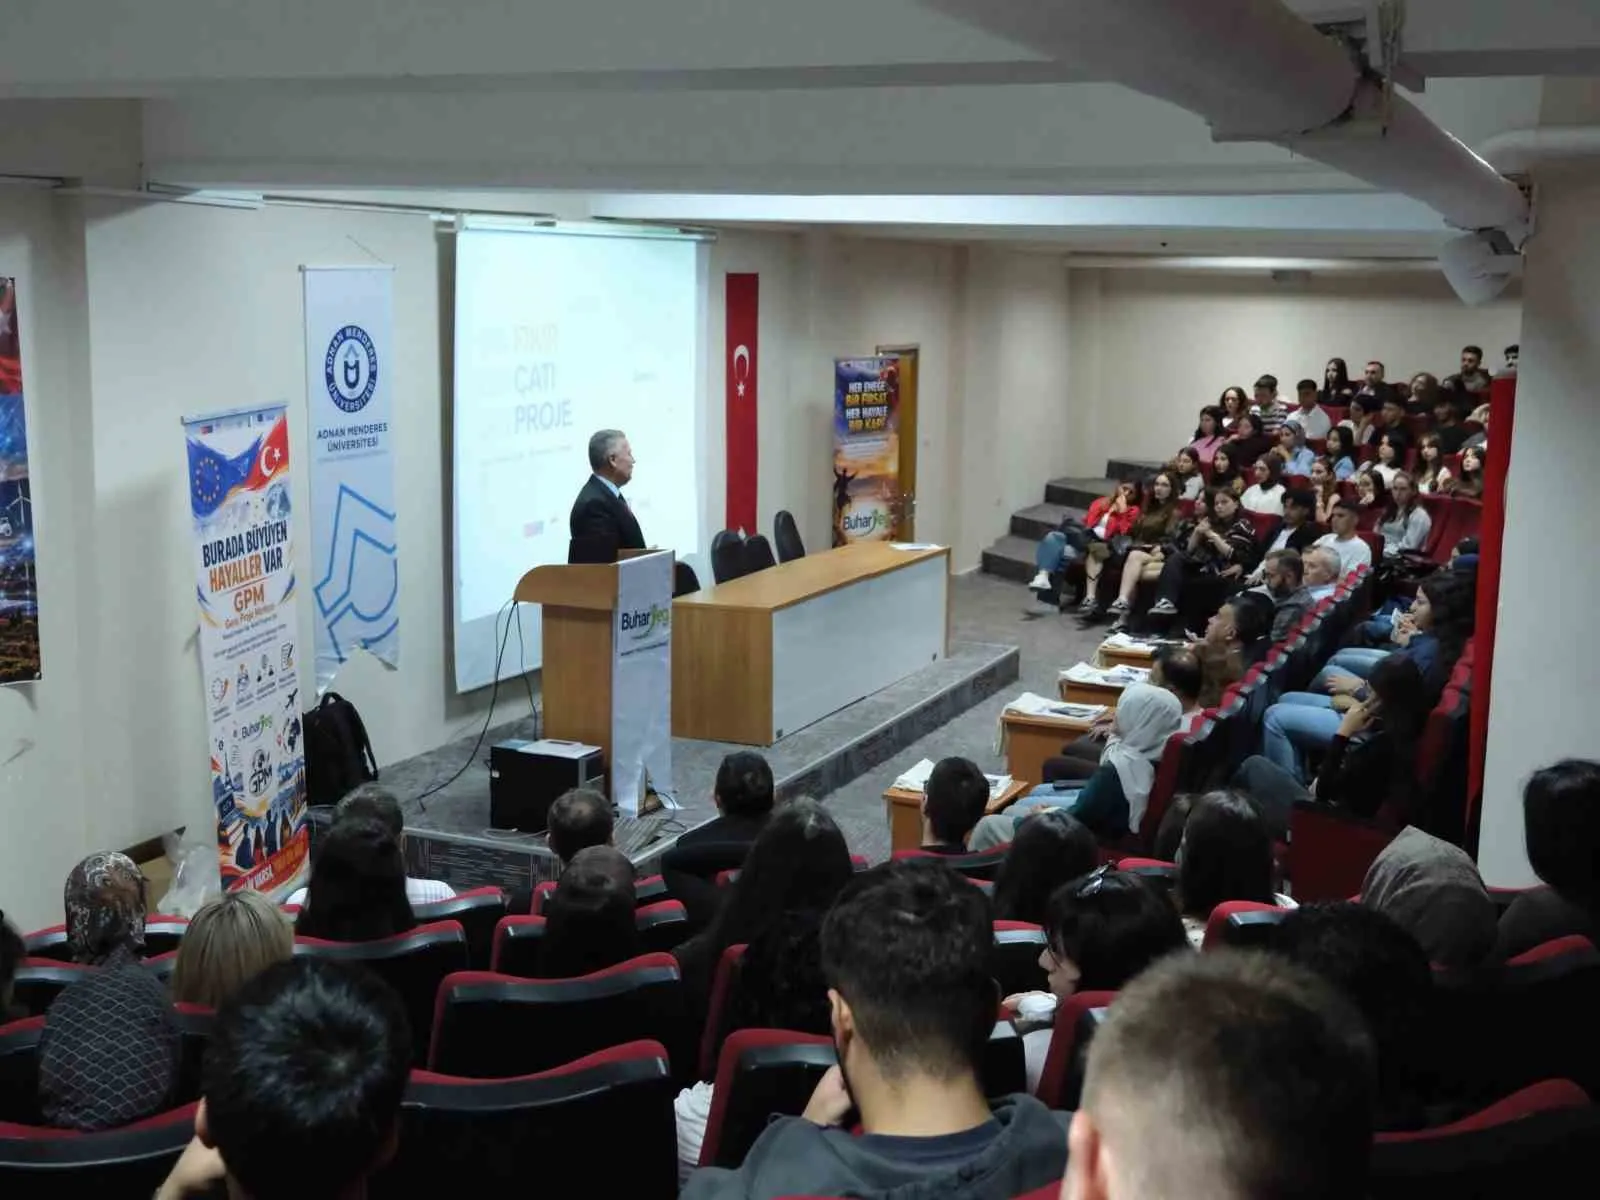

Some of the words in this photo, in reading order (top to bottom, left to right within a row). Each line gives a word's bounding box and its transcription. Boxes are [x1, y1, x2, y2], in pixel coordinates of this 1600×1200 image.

[317, 428, 346, 440] ADNAN
[347, 422, 388, 436] MENDERES
[514, 397, 573, 434] PROJE
[202, 533, 245, 568] BURADA
[246, 520, 287, 553] BÜYÜYEN
[209, 553, 262, 593] HAYALLER
[262, 547, 283, 574] VAR
[233, 584, 265, 613] GPM
